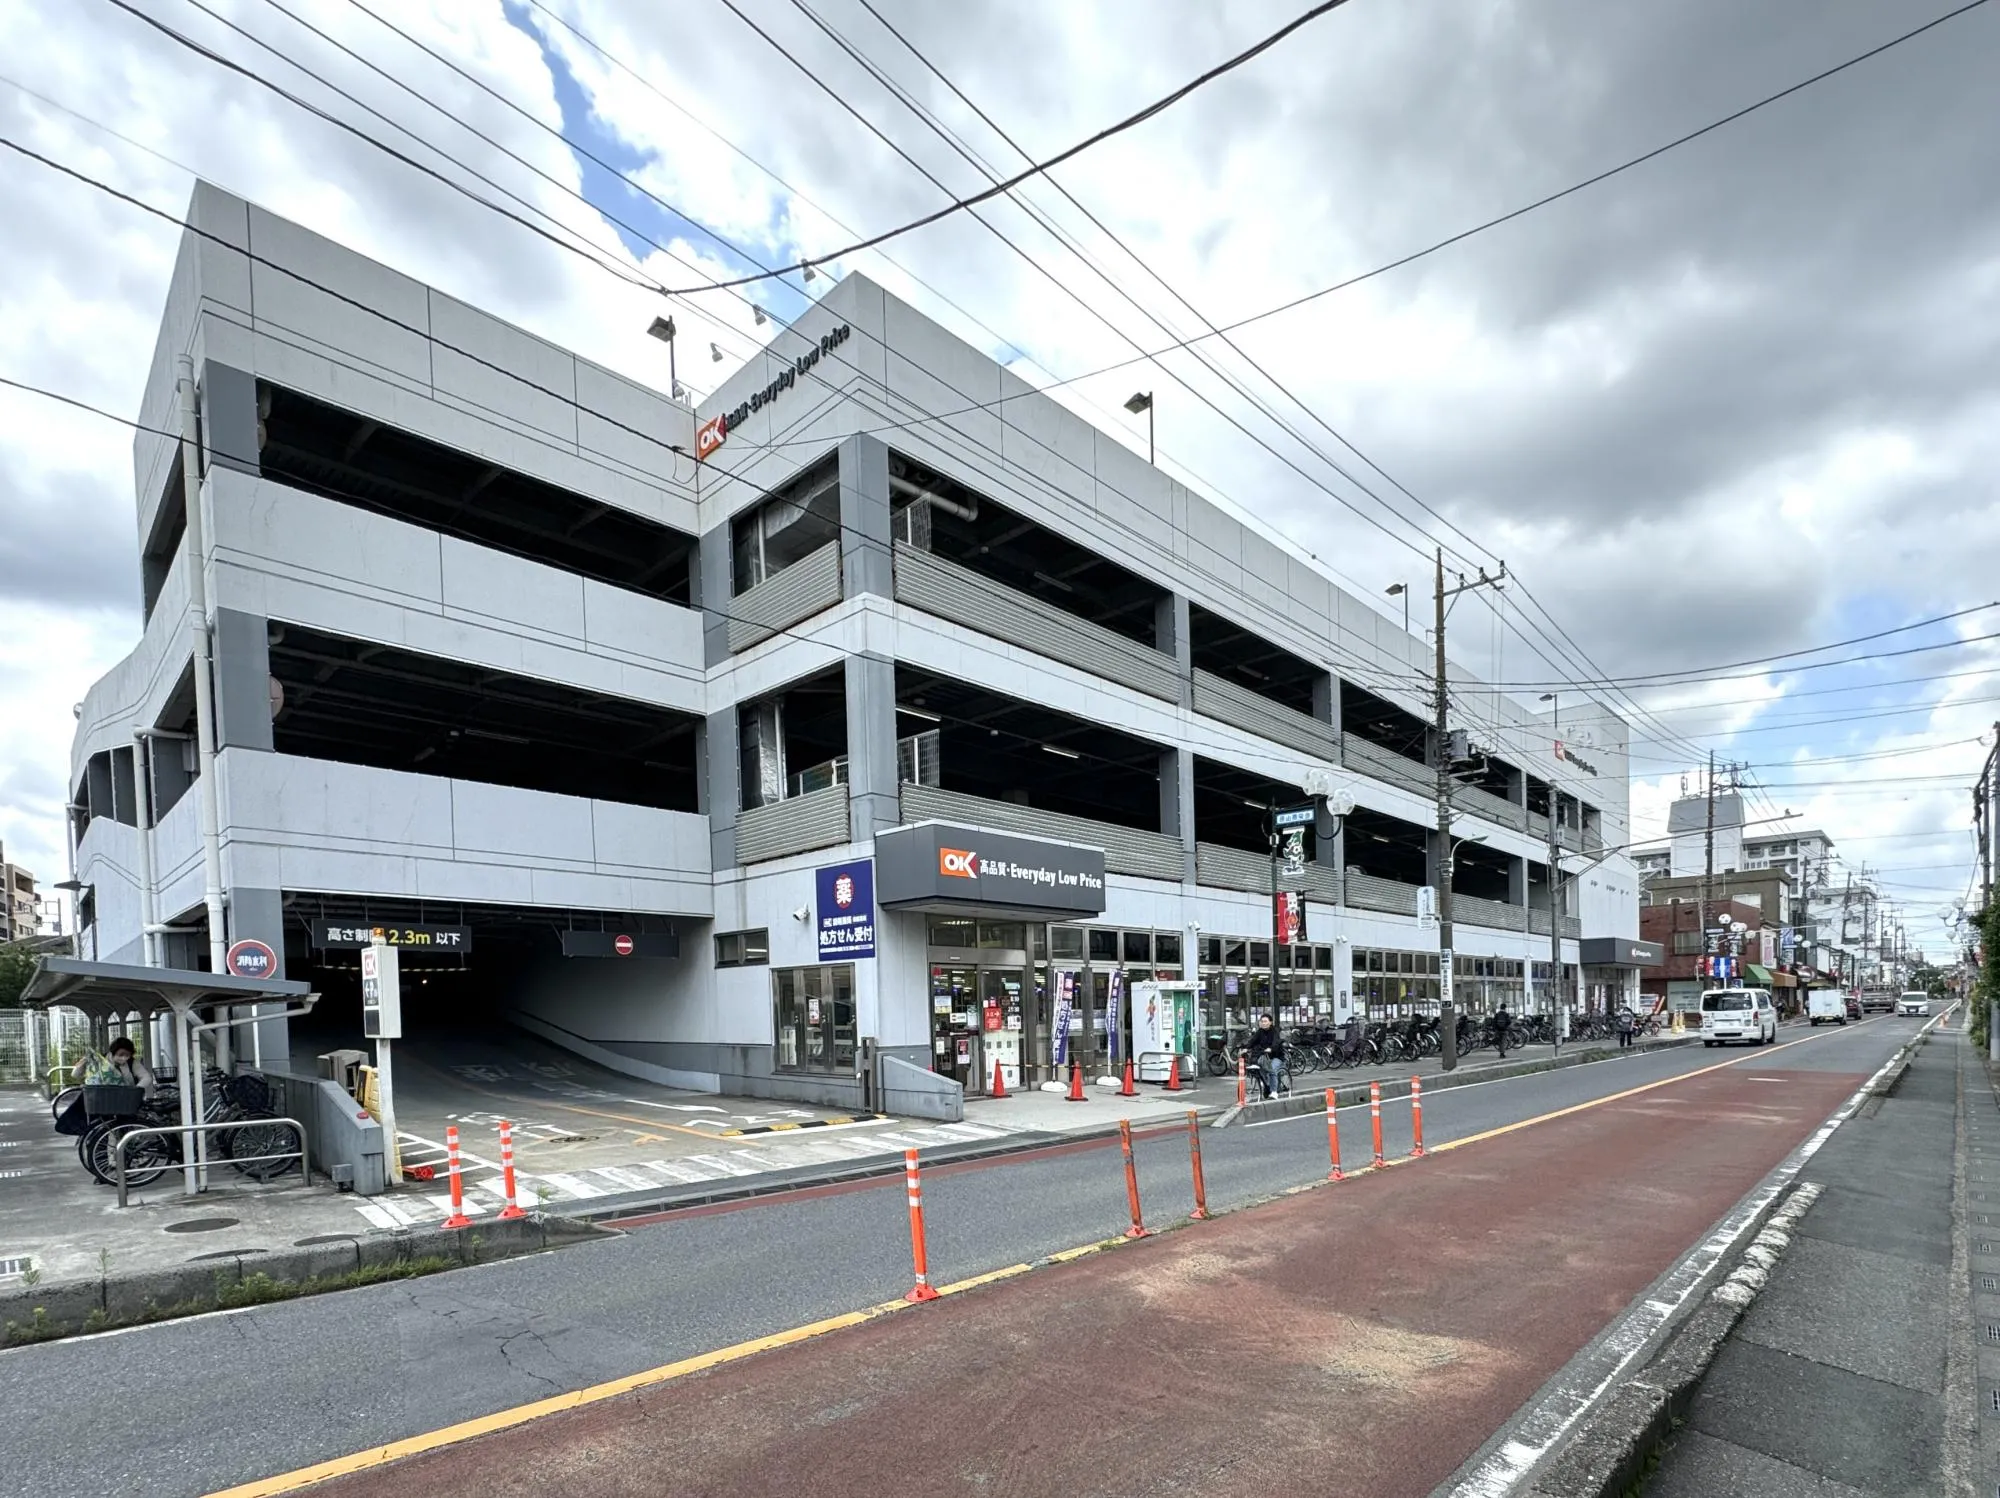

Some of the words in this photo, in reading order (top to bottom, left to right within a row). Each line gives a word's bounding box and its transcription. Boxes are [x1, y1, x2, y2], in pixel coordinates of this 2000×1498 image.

[700, 414, 727, 446] OK
[797, 347, 820, 376] Low
[820, 324, 850, 357] Price
[944, 852, 977, 879] OK
[1058, 869, 1077, 886] Low
[1079, 874, 1102, 889] Price
[835, 877, 852, 904] 薬
[327, 927, 374, 943] 高さ制
[388, 929, 431, 945] 2.3m
[435, 932, 461, 946] 以下
[819, 926, 873, 946] 処方せん受付
